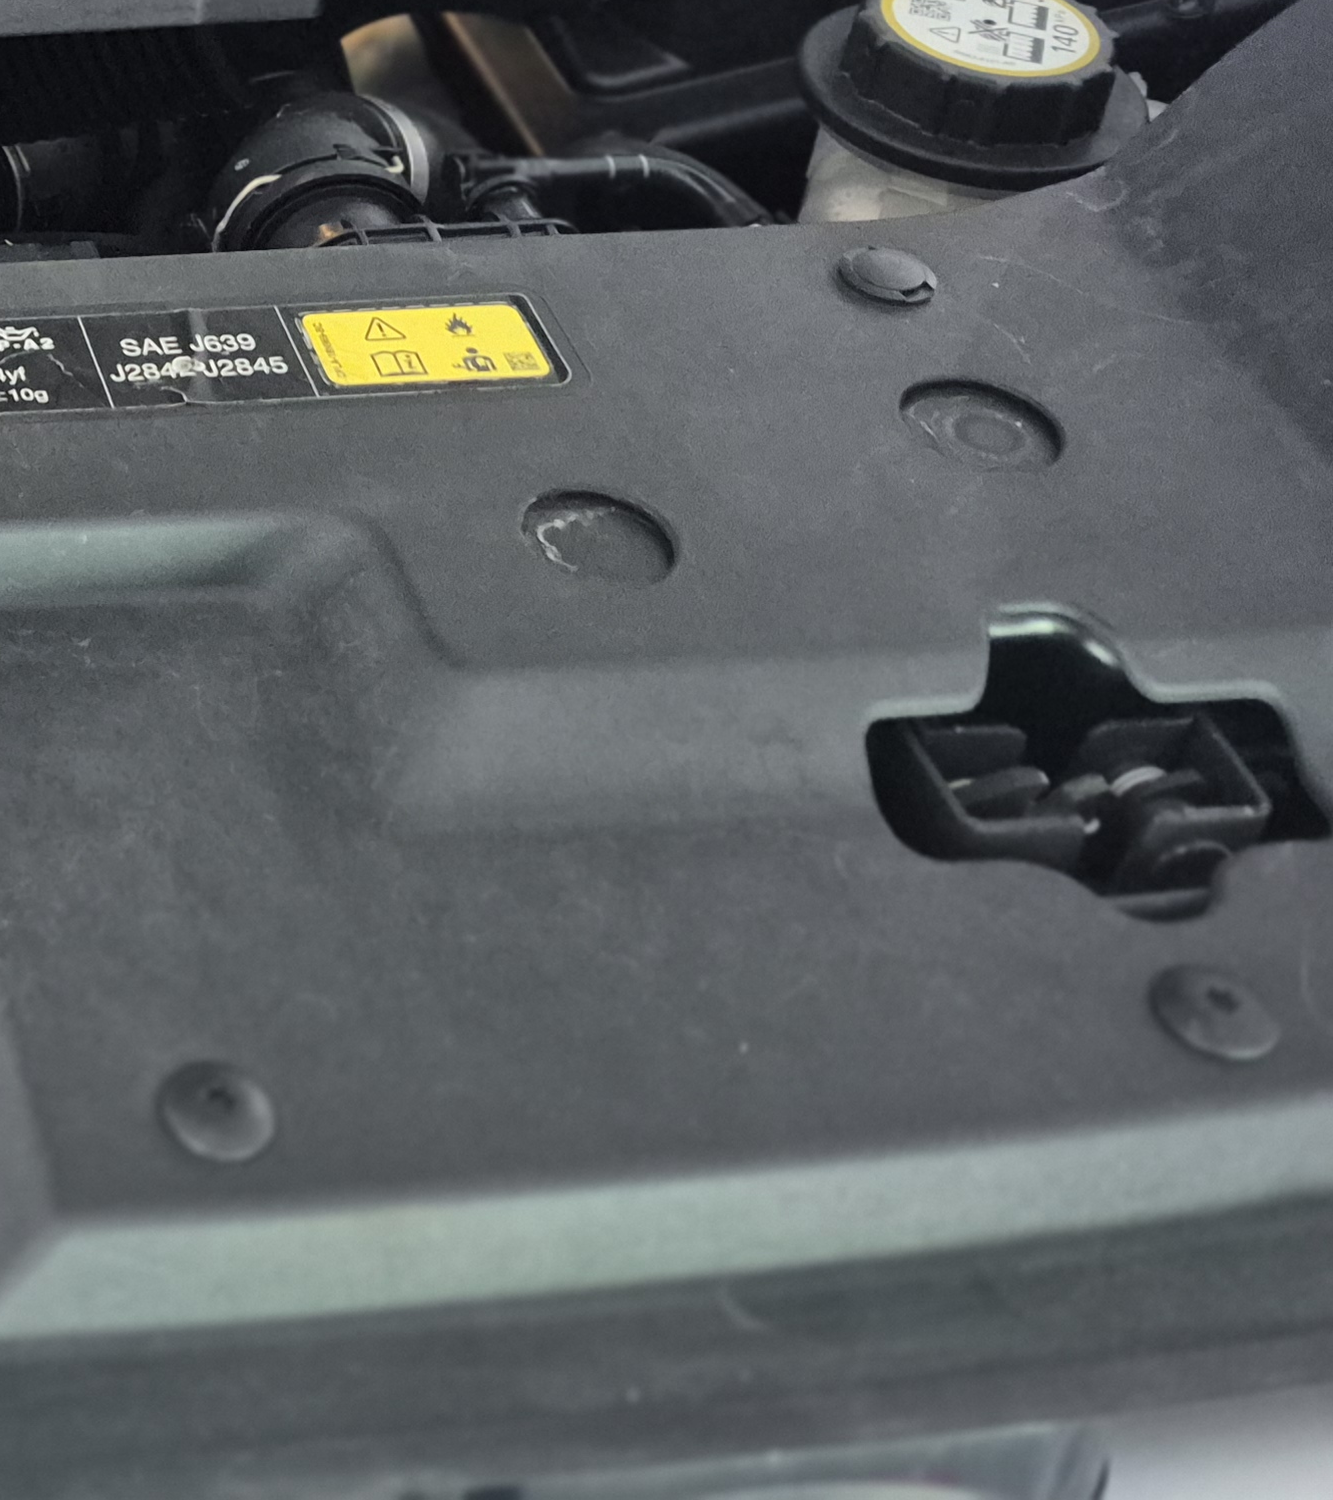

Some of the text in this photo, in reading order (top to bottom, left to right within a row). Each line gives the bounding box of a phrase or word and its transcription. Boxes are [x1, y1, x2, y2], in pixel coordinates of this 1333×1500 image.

[1051, 24, 1079, 53] 140
[119, 333, 257, 357] SAE J639
[202, 356, 289, 378] J2845
